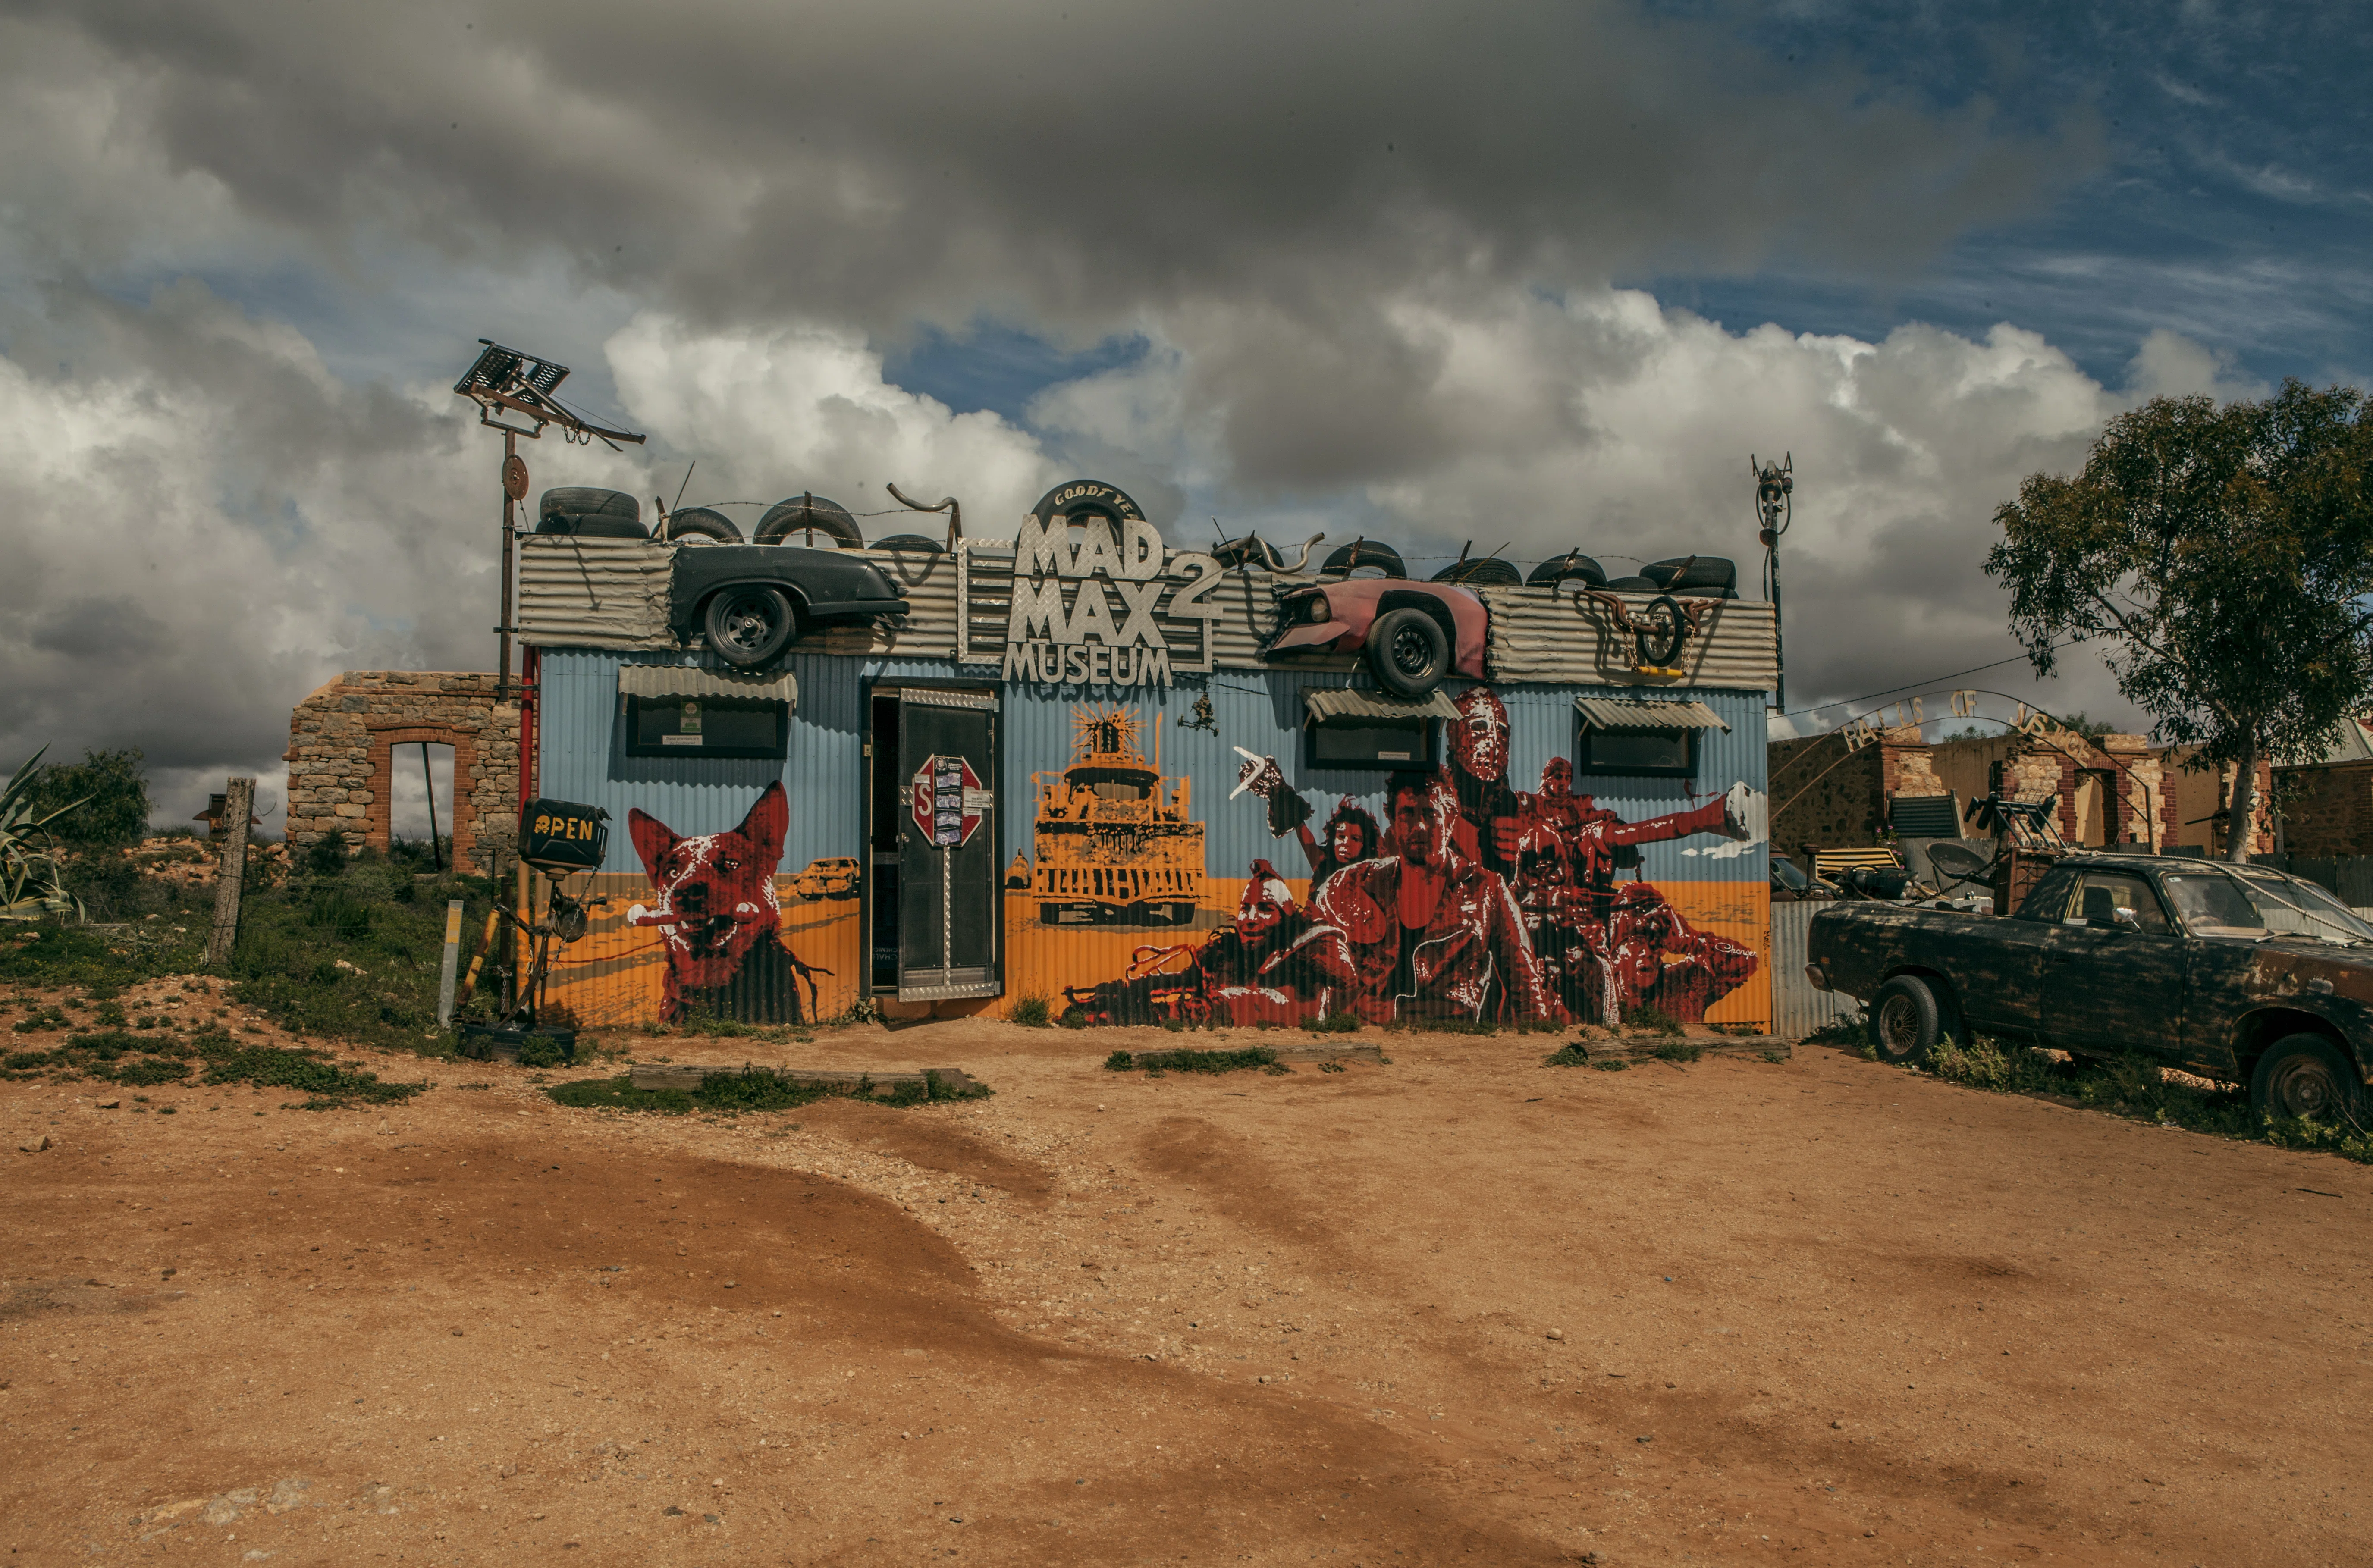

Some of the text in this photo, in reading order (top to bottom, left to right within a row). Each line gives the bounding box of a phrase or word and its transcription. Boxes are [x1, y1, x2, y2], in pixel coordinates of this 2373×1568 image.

[1014, 514, 1164, 580] MAD
[1008, 553, 1223, 648] MAX 2
[1001, 643, 1173, 687] MUSEUM
[1841, 696, 1924, 753] HALLS
[1950, 690, 1977, 718] OF
